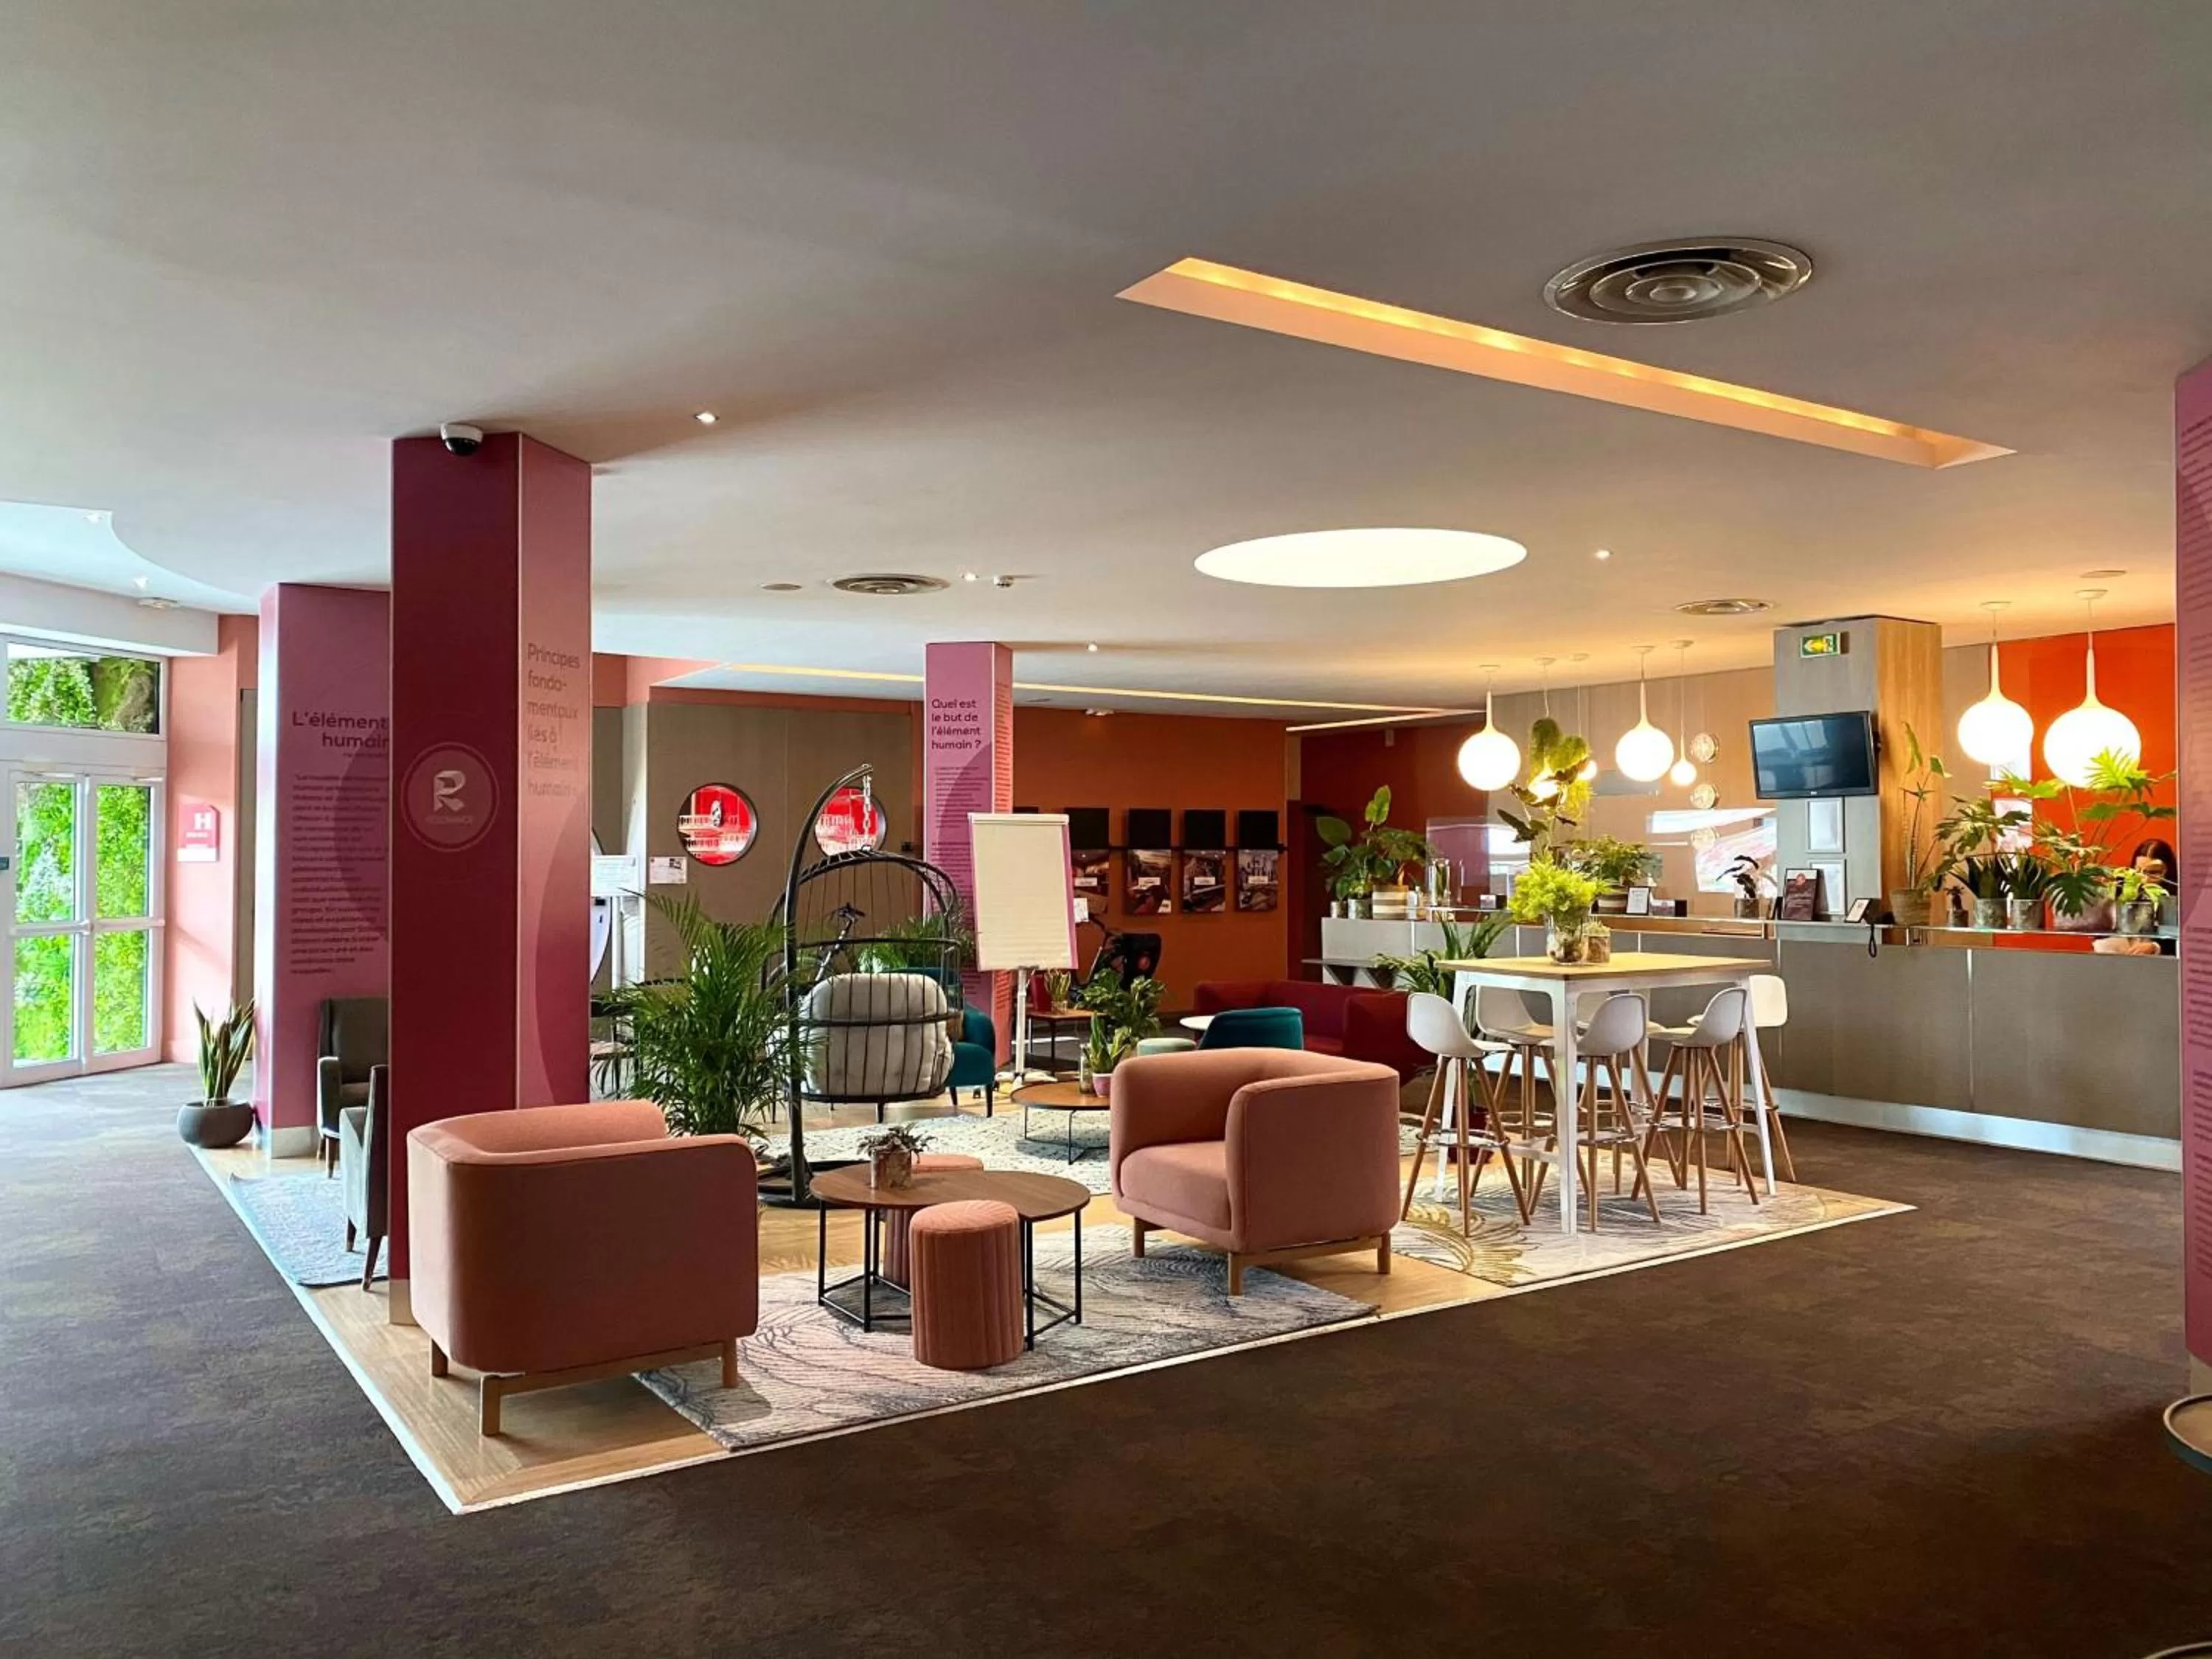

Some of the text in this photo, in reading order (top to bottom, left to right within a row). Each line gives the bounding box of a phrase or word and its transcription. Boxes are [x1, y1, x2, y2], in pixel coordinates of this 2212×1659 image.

[528, 642, 581, 669] Principes
[527, 700, 579, 719] mentaux
[931, 698, 977, 709] Quel est
[292, 711, 389, 728] L'élément
[931, 712, 978, 722] le but de
[931, 726, 981, 735] l'élément
[321, 731, 389, 748] humain
[931, 740, 982, 750] humain ?
[528, 750, 578, 769] l'élém
[194, 812, 212, 830] H
